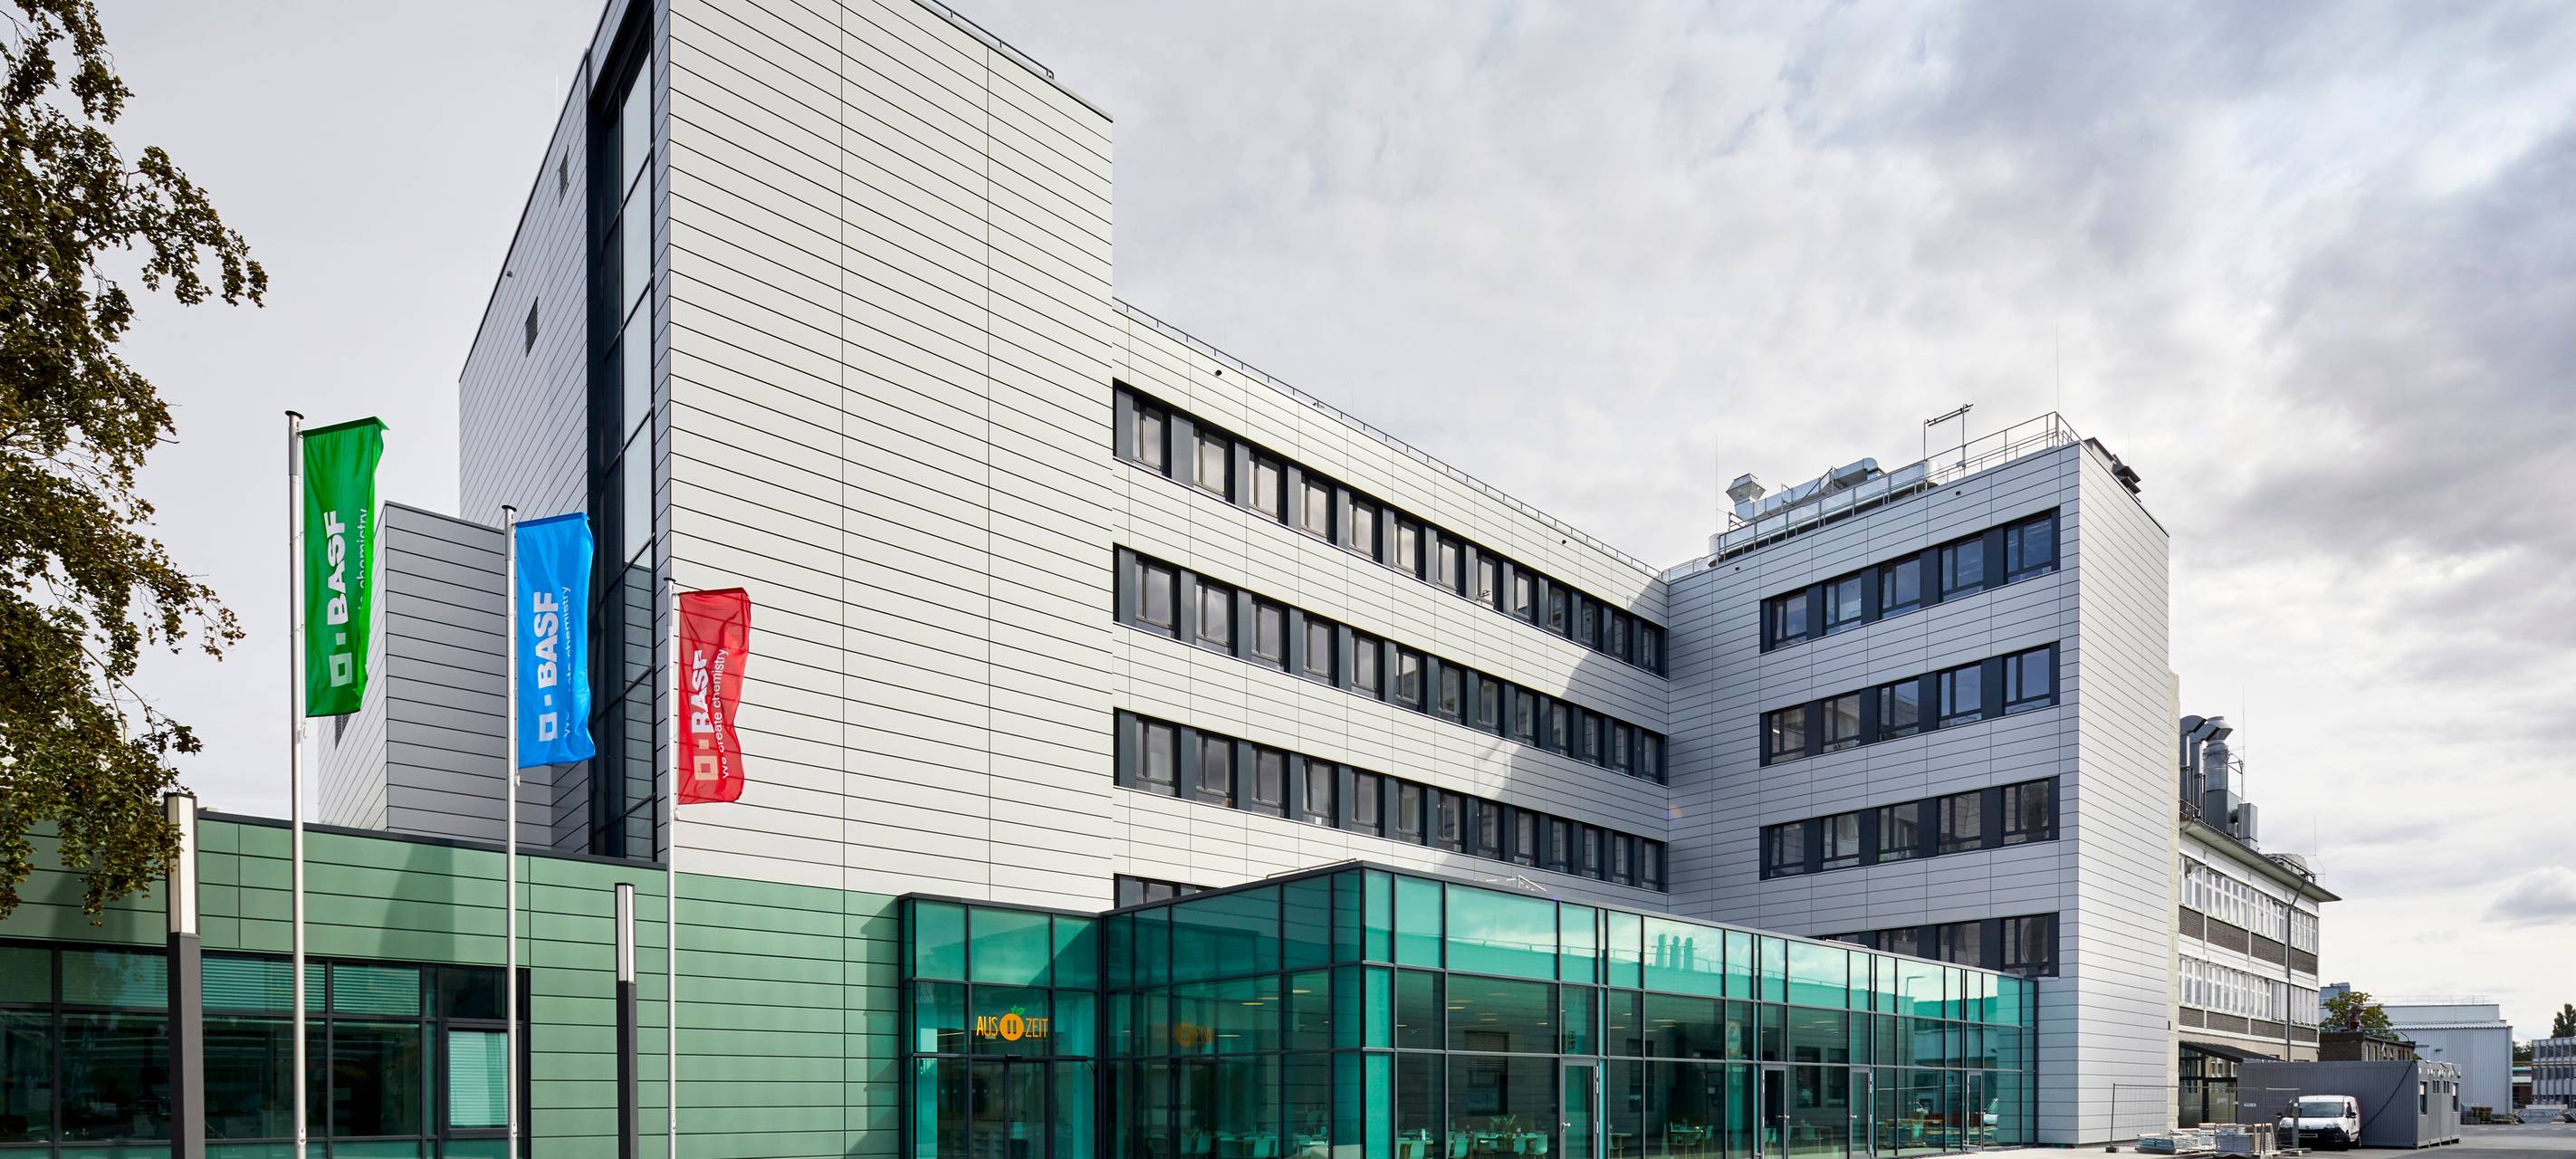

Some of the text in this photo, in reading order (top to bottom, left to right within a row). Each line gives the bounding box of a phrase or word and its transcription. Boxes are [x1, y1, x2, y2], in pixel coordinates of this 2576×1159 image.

[323, 510, 349, 625] BASF
[533, 591, 559, 689] BASF
[691, 649, 715, 733] BASF
[711, 649, 730, 708] chemistry
[713, 712, 724, 753] create
[976, 1015, 1049, 1038] AUS ZEIT
